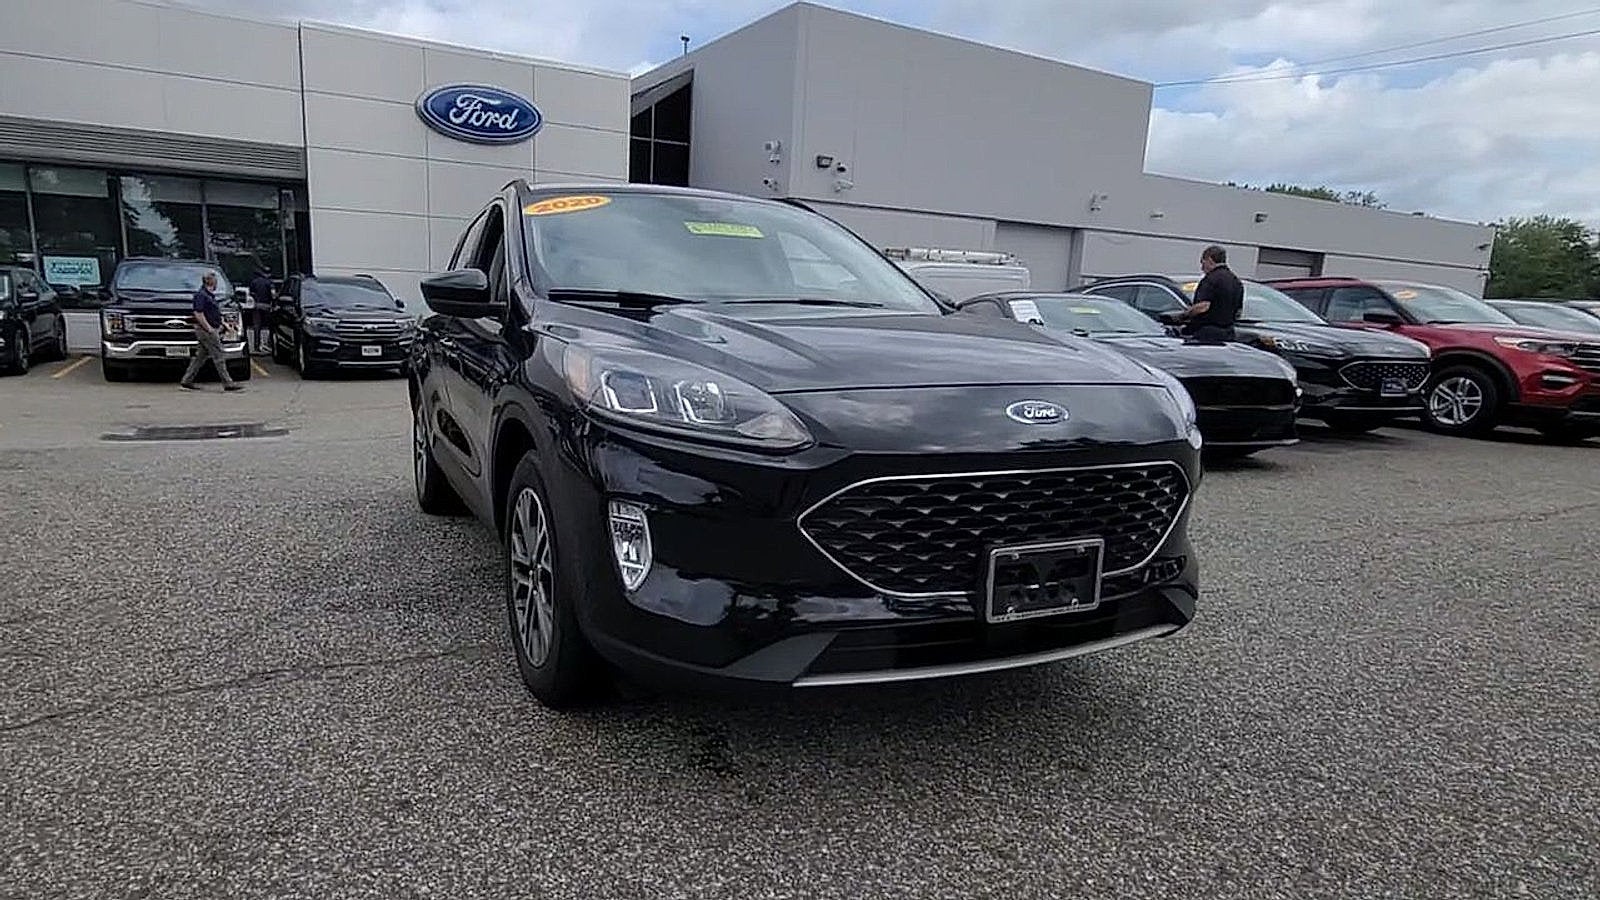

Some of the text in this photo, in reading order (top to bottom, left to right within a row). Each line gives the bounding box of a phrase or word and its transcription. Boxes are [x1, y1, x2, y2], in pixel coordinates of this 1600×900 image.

[449, 94, 519, 129] Ford
[533, 197, 599, 212] 2020
[1023, 404, 1059, 418] Ford
